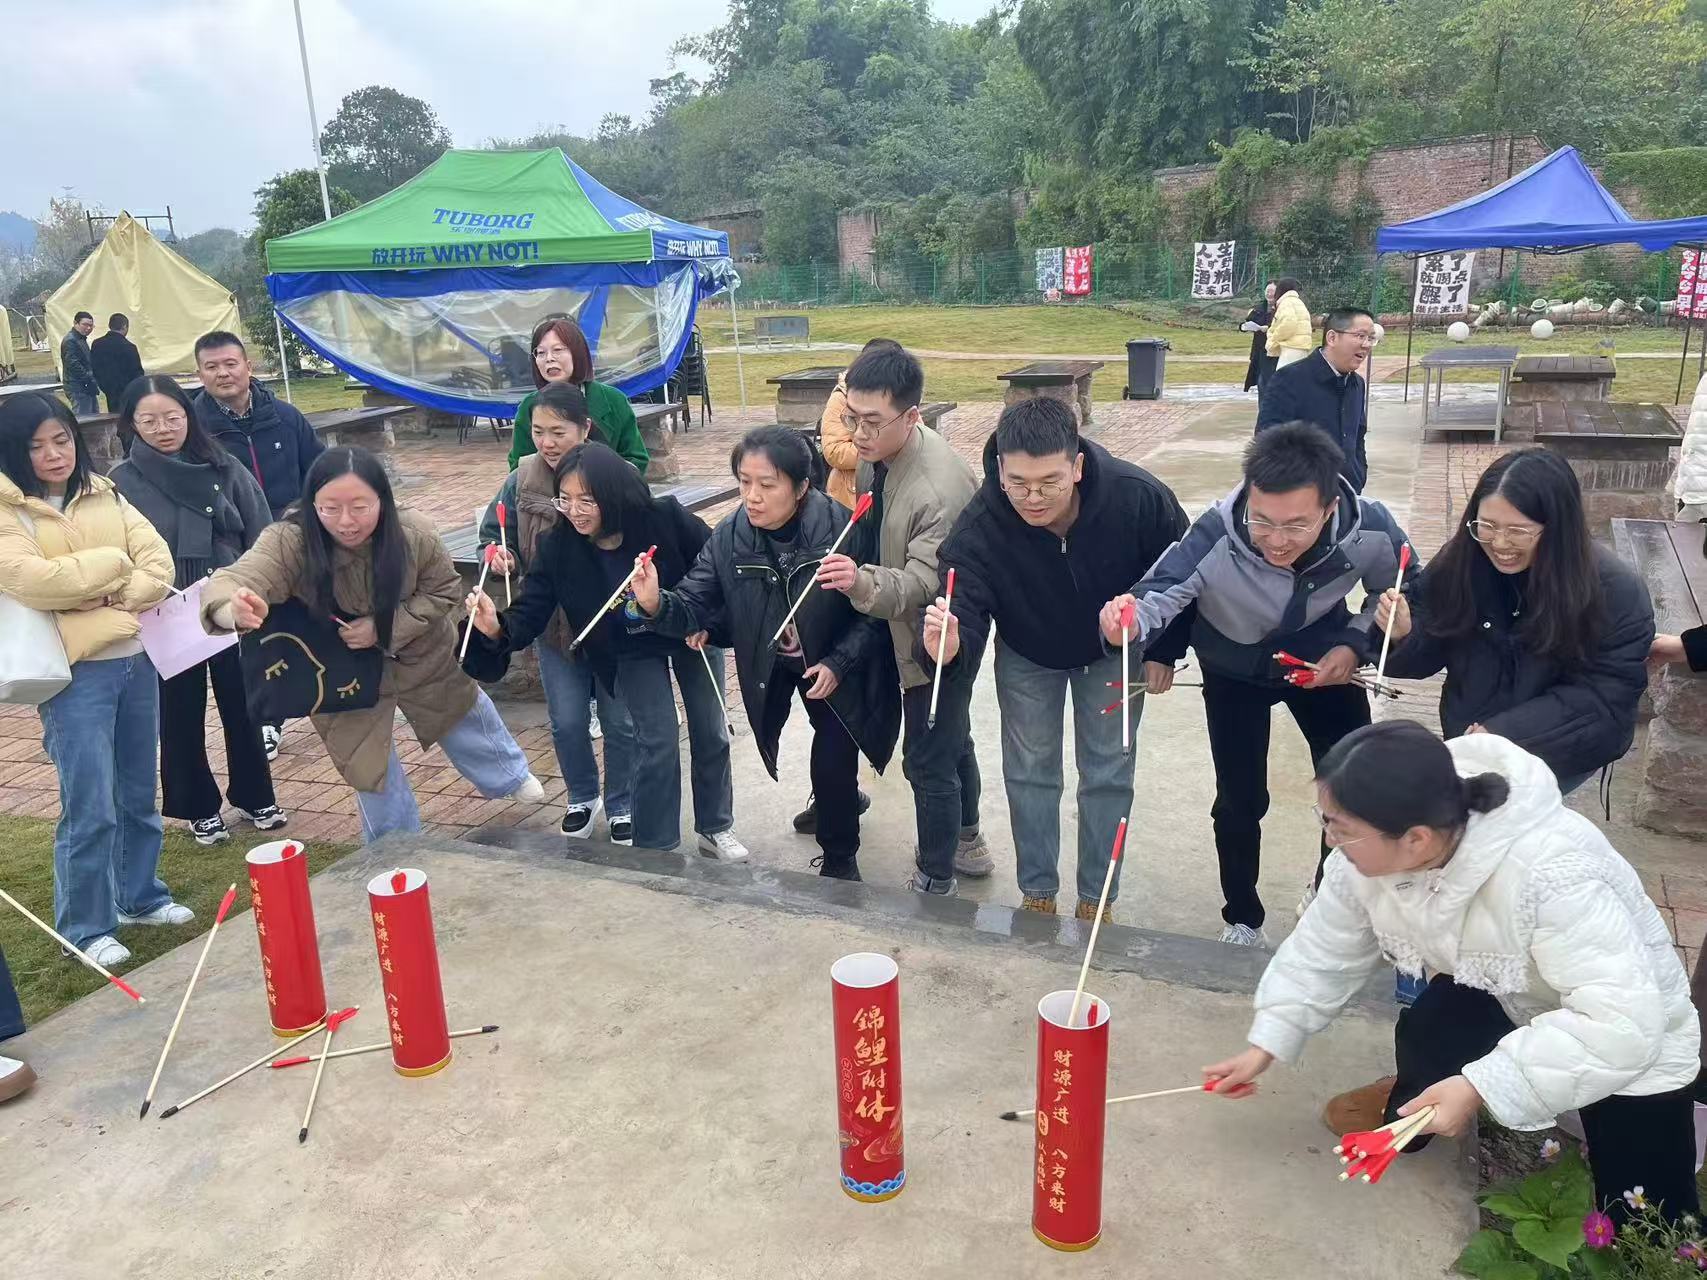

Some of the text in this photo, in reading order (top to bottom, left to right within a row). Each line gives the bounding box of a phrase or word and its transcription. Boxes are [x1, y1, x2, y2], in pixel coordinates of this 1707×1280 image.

[432, 207, 534, 229] TUBORG
[372, 242, 538, 265] 放开玩 WHY NOT!
[1196, 243, 1232, 258] 人生
[374, 912, 393, 973] 财源广进
[1049, 1050, 1073, 1214] 财源广进 八方来财
